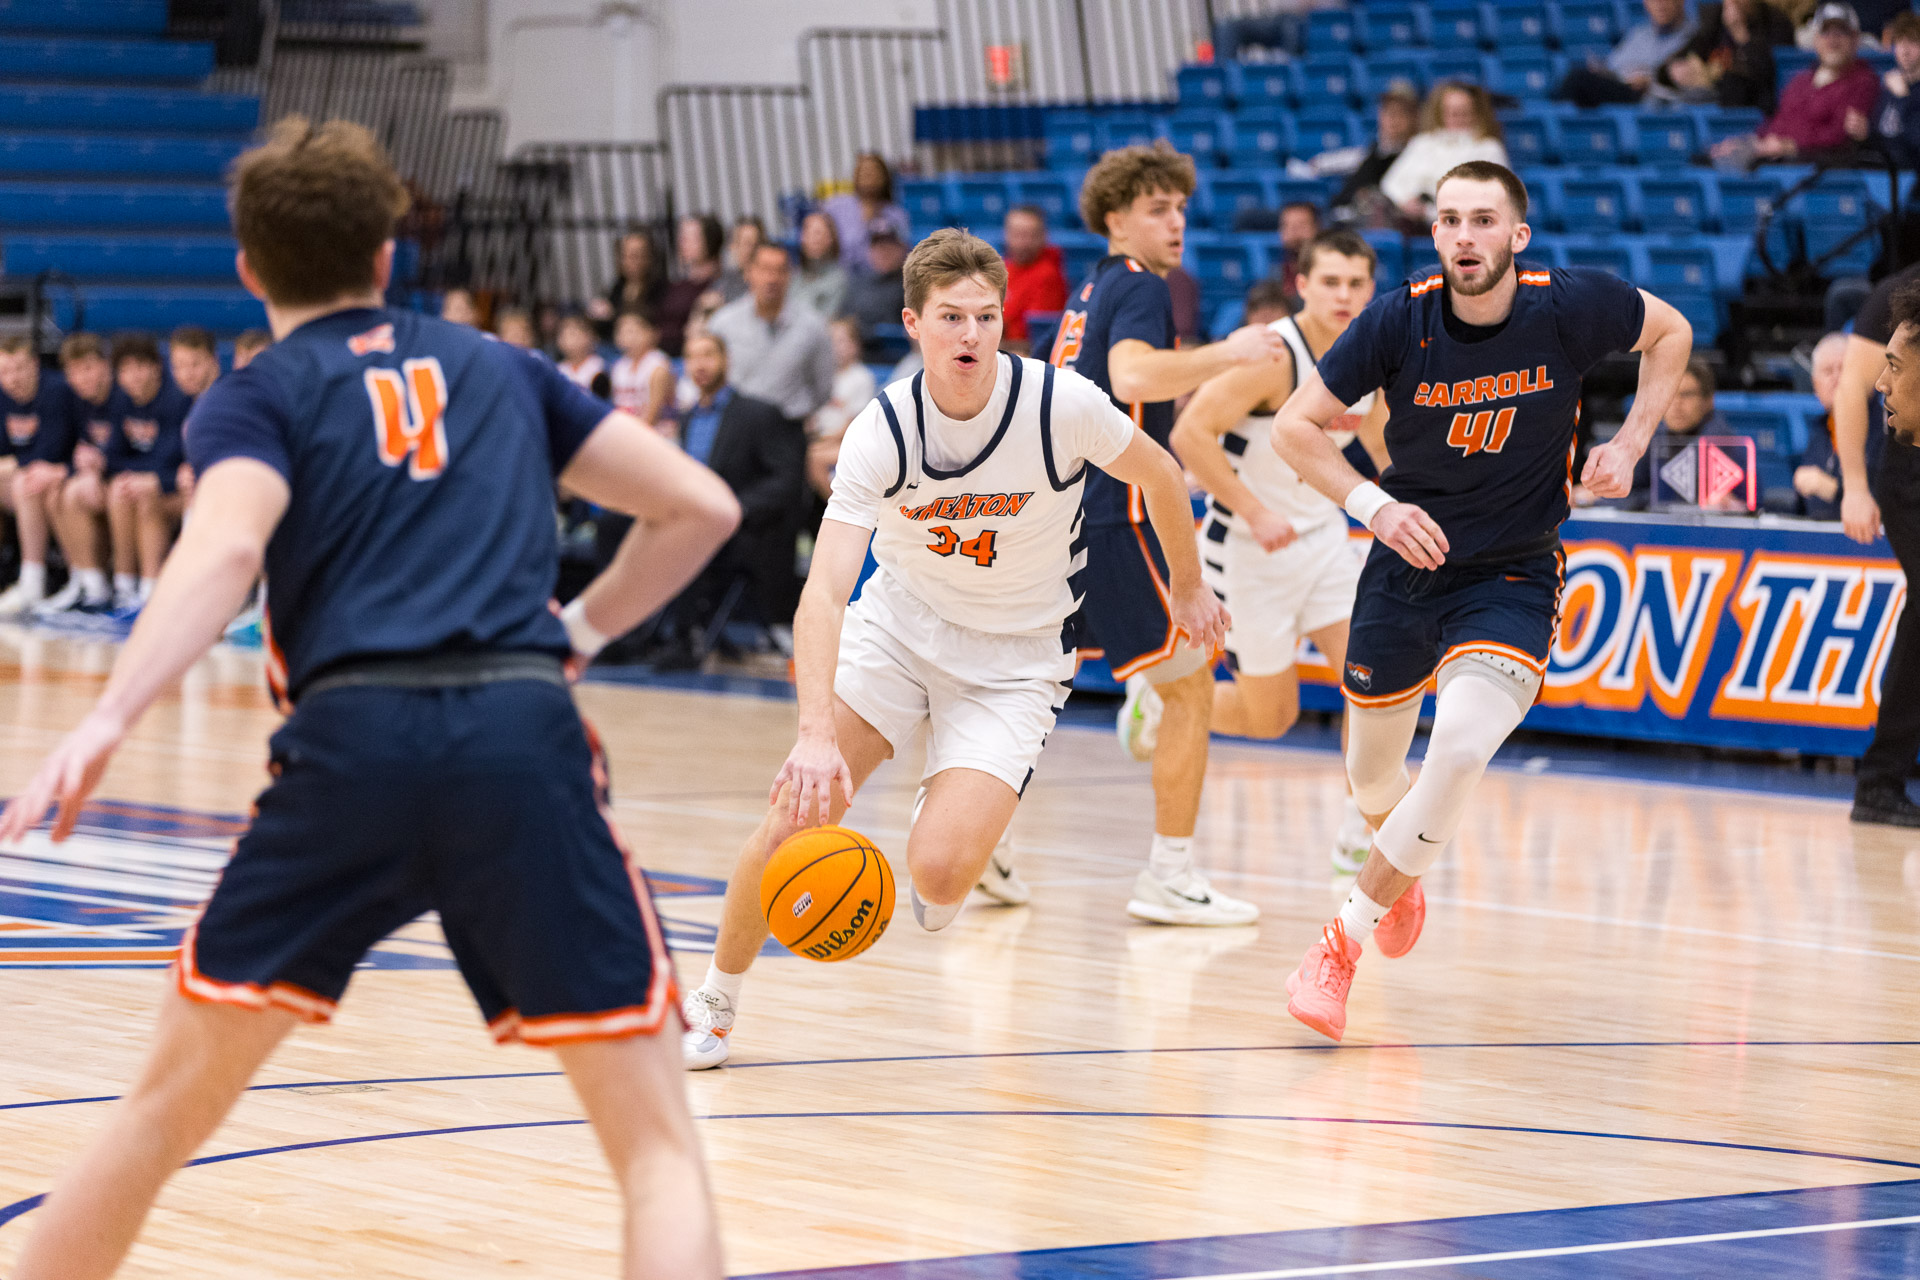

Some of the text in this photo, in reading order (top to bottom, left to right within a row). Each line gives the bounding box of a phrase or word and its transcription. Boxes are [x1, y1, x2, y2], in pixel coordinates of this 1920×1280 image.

[1413, 365, 1554, 408] CARROLL
[363, 355, 449, 482] 4
[1446, 406, 1518, 458] 41
[926, 525, 999, 568] 34
[1723, 560, 1908, 709] TH
[802, 898, 875, 959] Wilson
